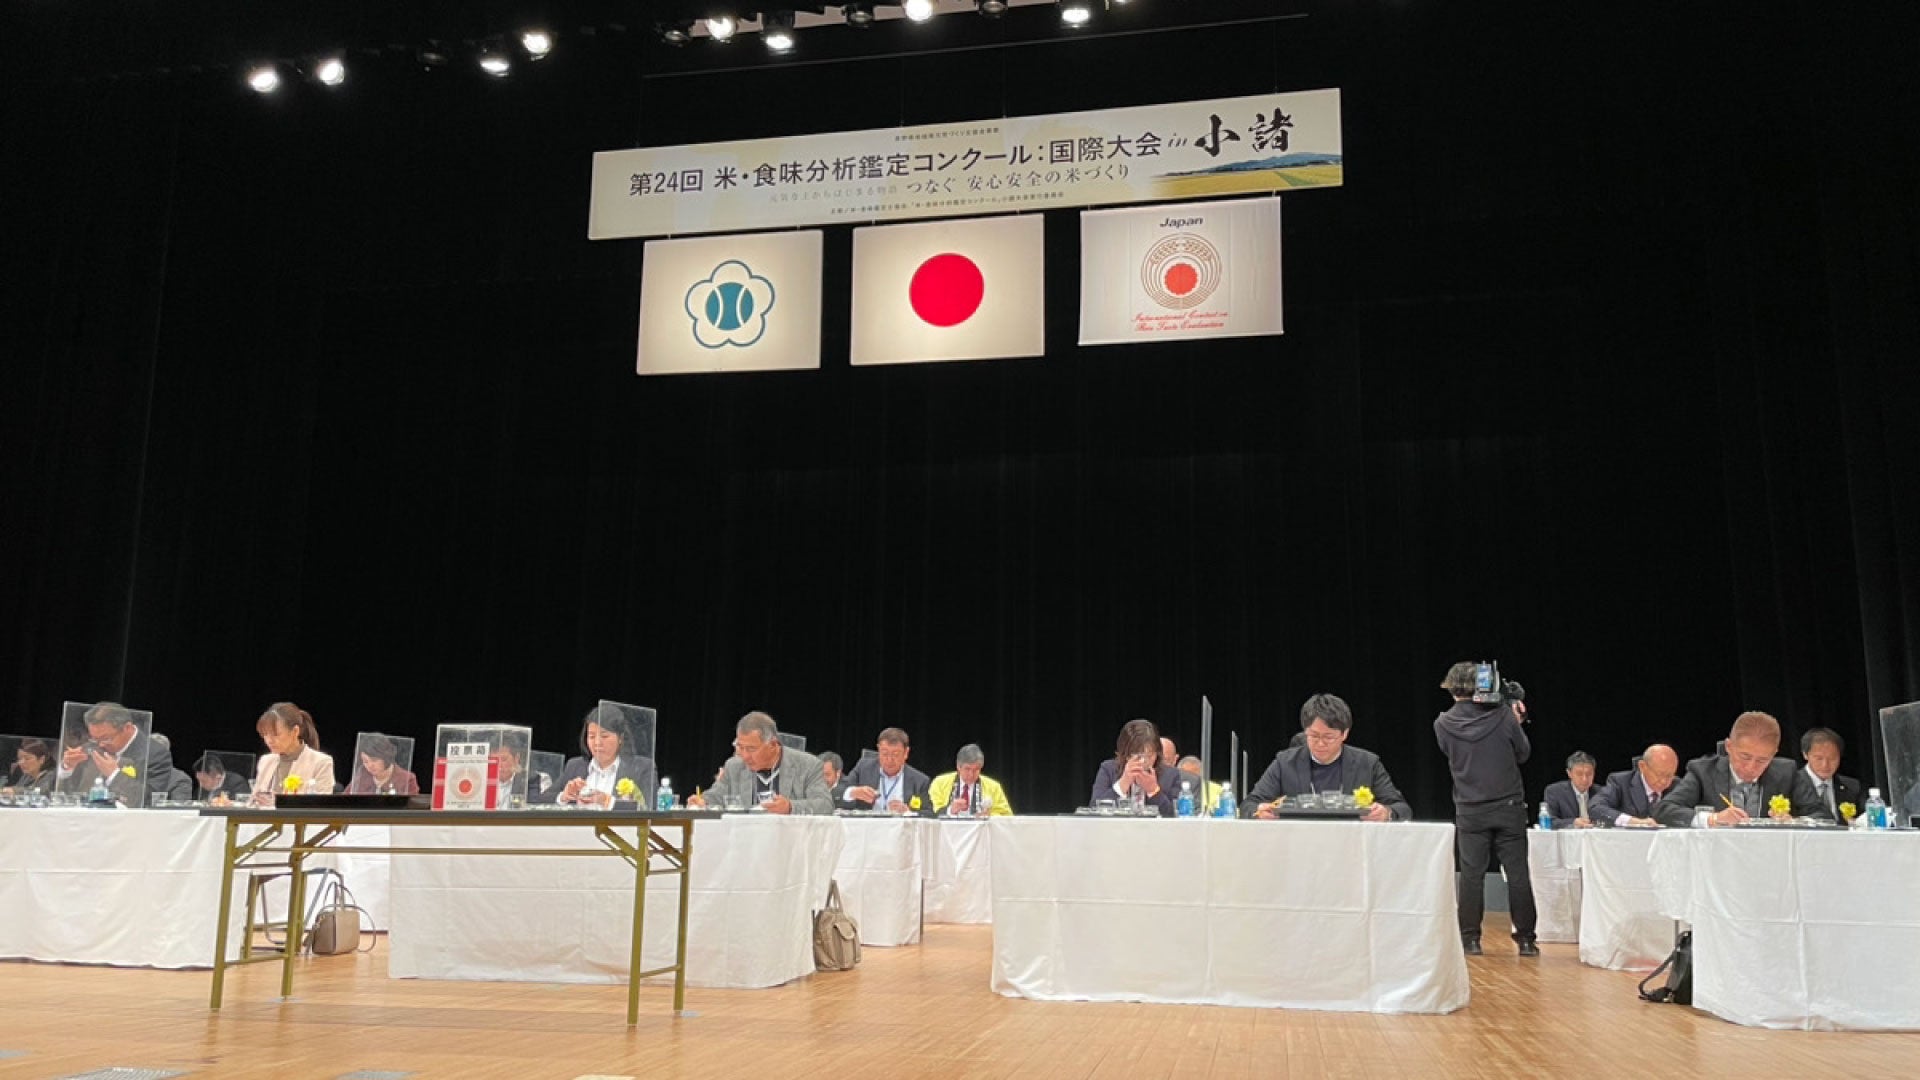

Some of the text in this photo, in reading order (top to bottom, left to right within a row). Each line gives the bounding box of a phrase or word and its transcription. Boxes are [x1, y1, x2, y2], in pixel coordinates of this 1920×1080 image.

[630, 169, 703, 196] 第24回
[1168, 132, 1189, 148] in
[1195, 107, 1294, 157] 小諸
[906, 176, 956, 193] つなぐ
[967, 164, 1129, 191] 安心安全の米づくり
[1160, 217, 1203, 229] Japan
